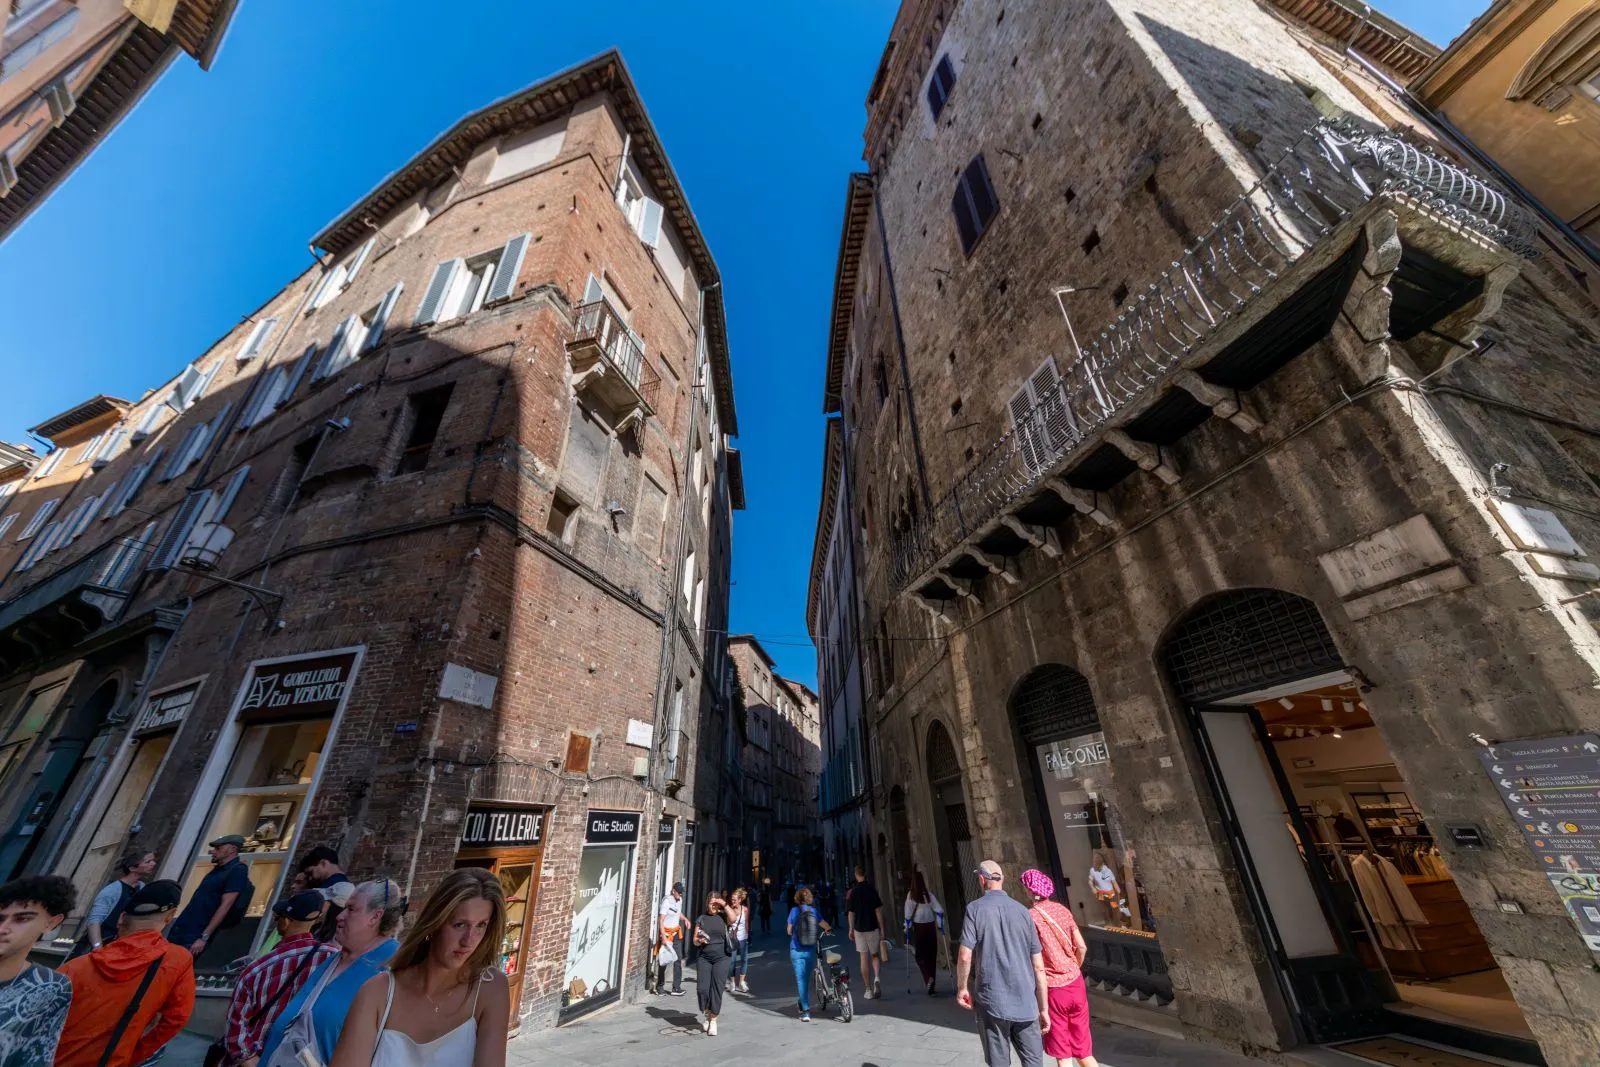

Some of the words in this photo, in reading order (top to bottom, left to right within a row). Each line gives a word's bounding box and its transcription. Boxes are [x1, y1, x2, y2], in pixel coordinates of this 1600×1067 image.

[1360, 543, 1387, 557] VIA
[1351, 568, 1367, 580] DI
[292, 681, 346, 705] VERSACE
[463, 813, 543, 842] COLTELLERIE
[592, 821, 609, 832] Chic
[610, 821, 634, 832] Studio
[579, 887, 599, 898] TUTTO
